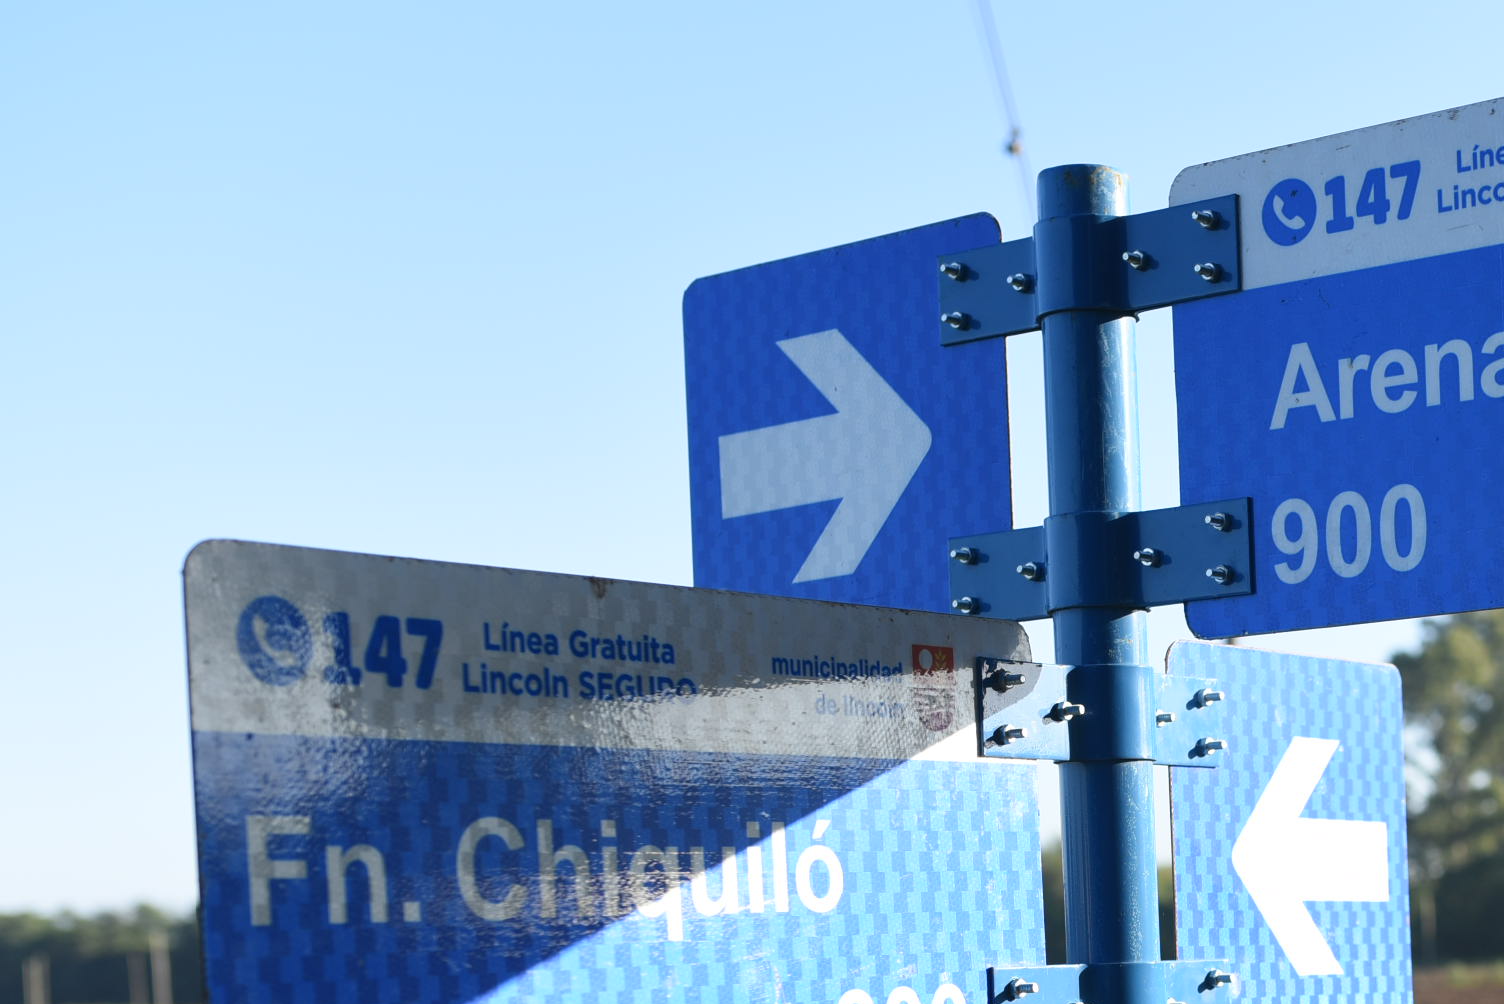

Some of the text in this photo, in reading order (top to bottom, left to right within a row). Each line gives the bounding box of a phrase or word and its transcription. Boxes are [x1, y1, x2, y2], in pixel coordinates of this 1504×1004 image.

[1324, 160, 1421, 234] 147
[1271, 482, 1428, 584] 900
[323, 611, 443, 689] 147
[462, 662, 568, 698] Lincoln
[483, 621, 676, 664] Línea Gratuita
[245, 815, 844, 941] Fn. Chiquiló
